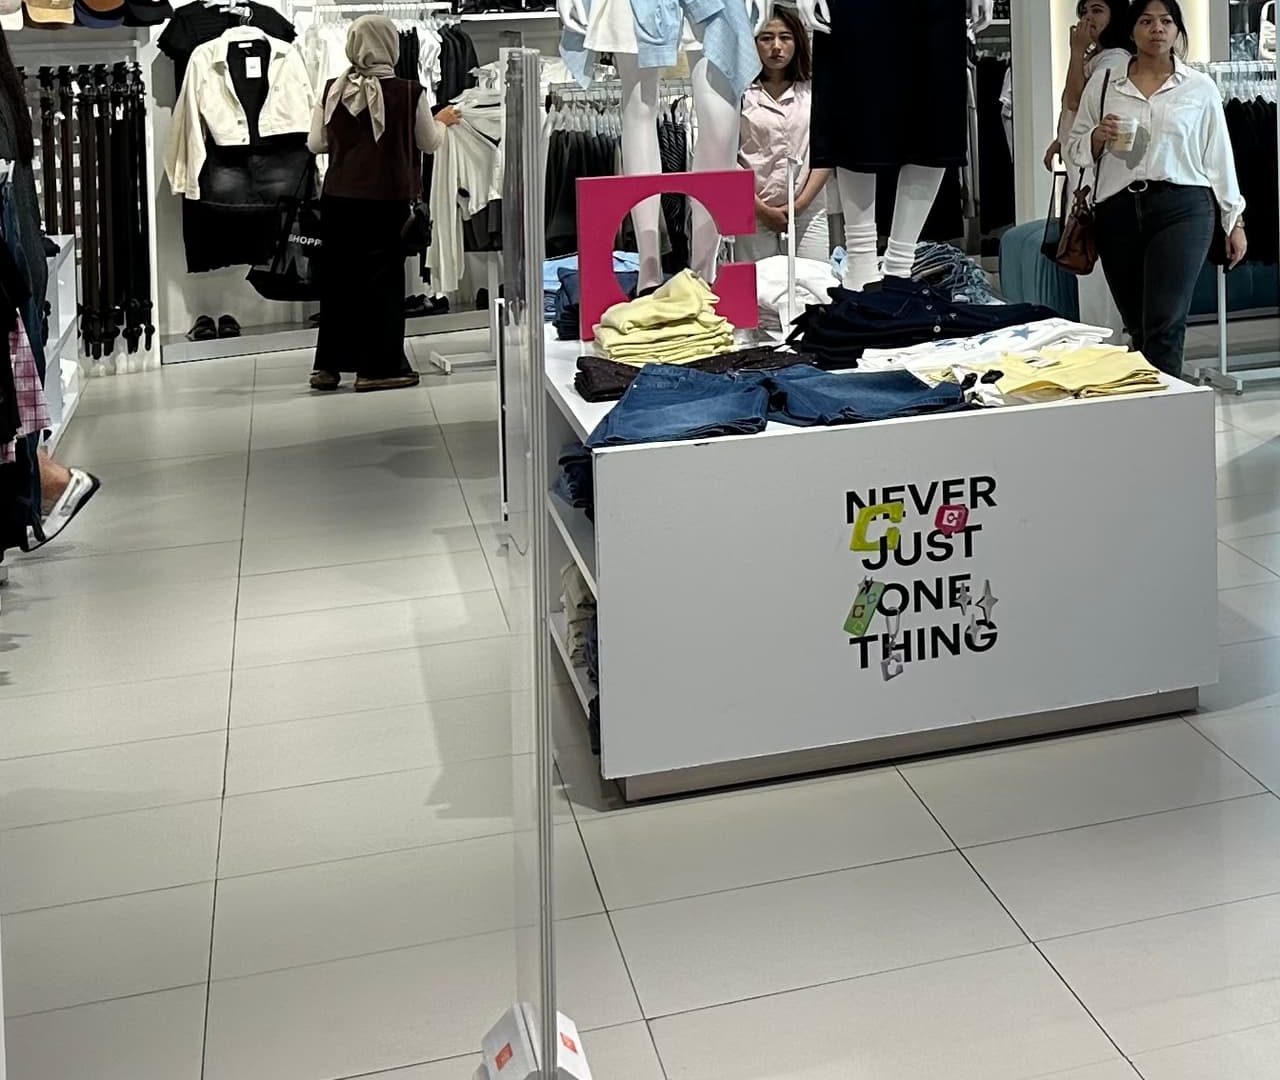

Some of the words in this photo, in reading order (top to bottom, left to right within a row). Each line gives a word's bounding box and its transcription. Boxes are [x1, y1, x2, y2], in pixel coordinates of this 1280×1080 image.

[846, 475, 998, 524] NEVER
[861, 524, 983, 570] JUST
[876, 573, 972, 617] ONE
[849, 619, 998, 669] THING
